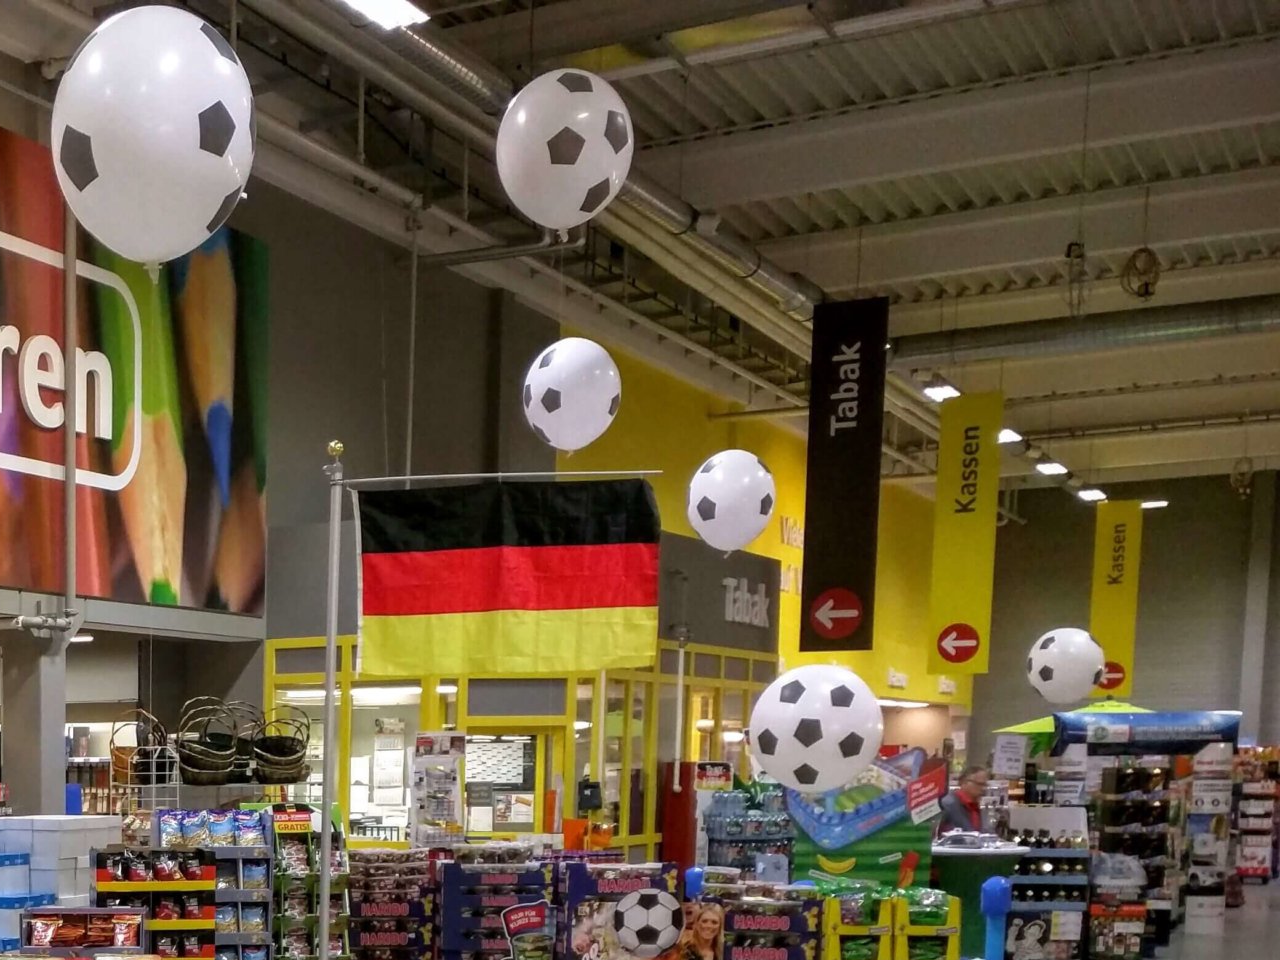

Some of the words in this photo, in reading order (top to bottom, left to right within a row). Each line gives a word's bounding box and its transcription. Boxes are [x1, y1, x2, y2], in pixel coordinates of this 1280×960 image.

[830, 341, 861, 437] Tabak
[955, 425, 981, 514] Kassen
[1106, 522, 1128, 586] Kassen
[722, 577, 769, 628] Tabak
[360, 902, 410, 916] HARIBO
[734, 915, 790, 931] HARIBO
[359, 931, 409, 945] HARIBO
